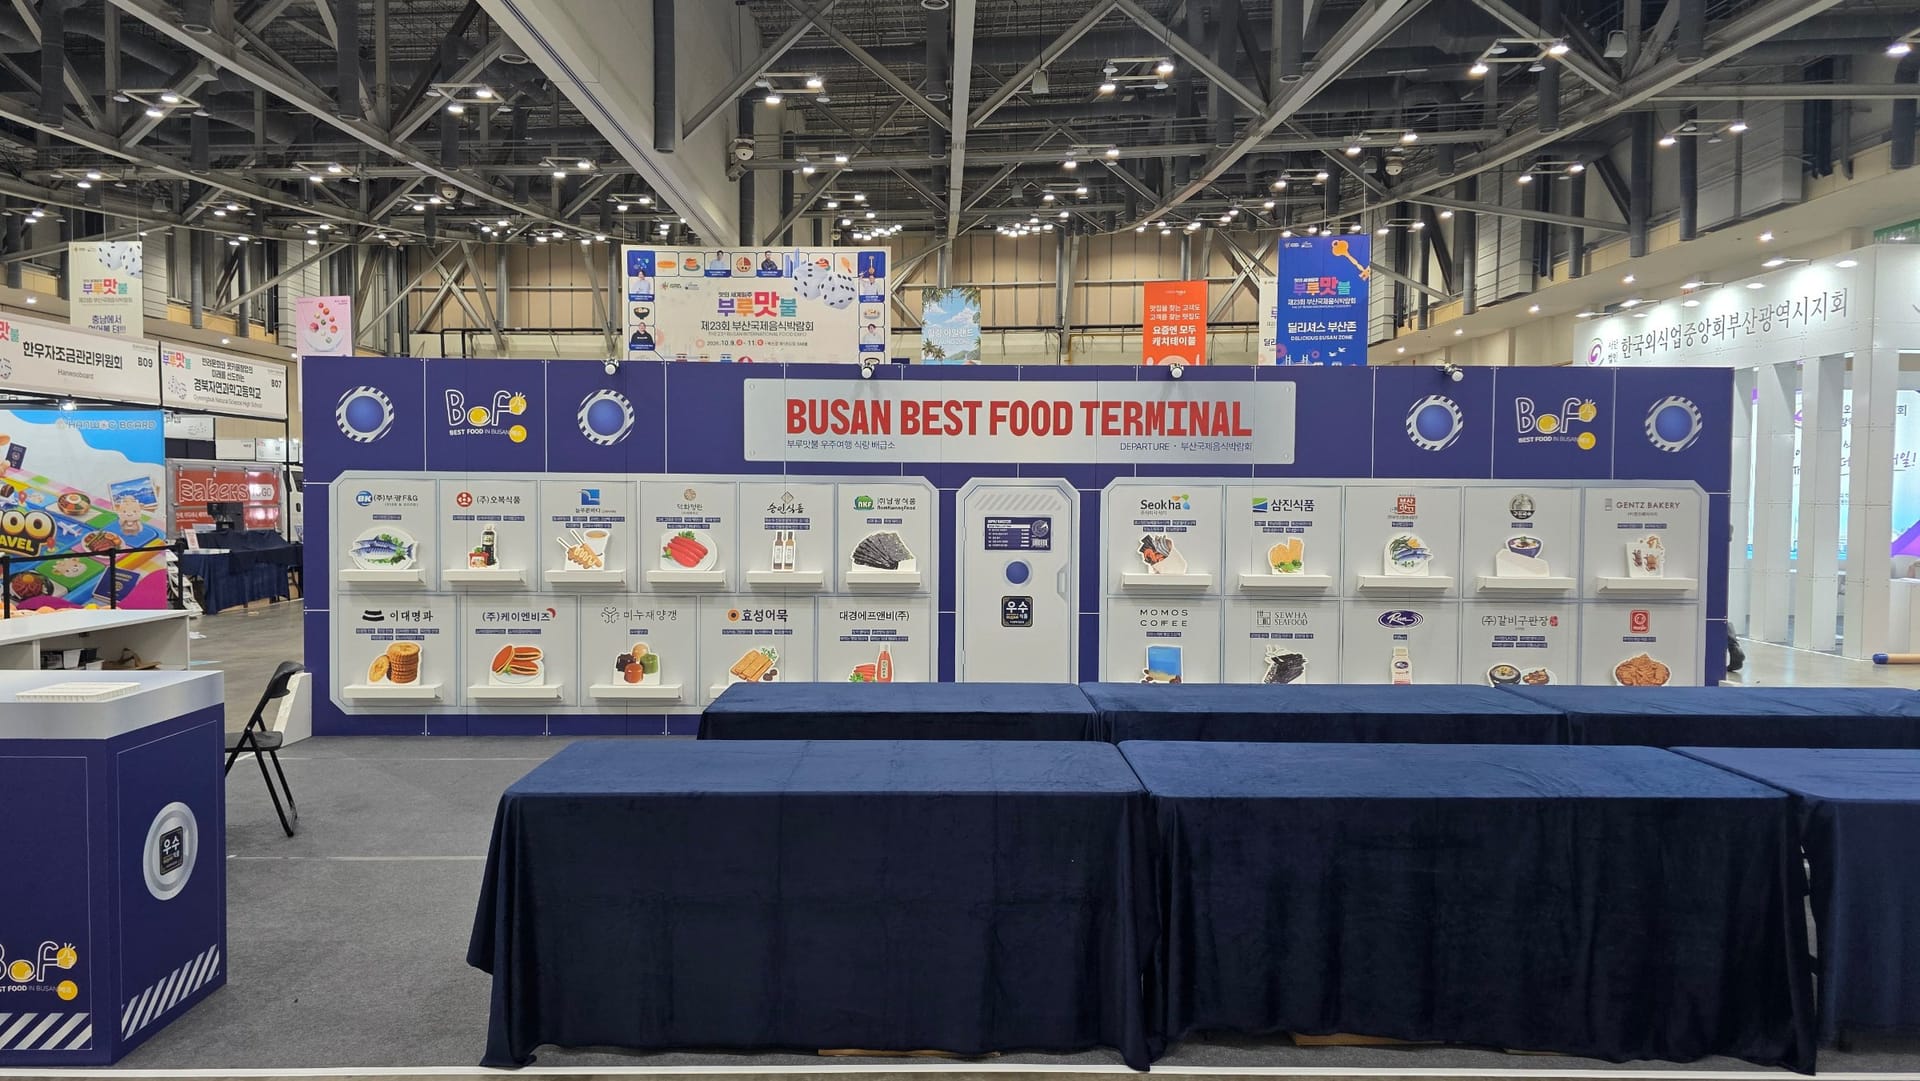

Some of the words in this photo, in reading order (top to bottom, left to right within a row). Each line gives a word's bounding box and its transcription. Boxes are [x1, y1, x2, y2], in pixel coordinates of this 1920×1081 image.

[1293, 277, 1351, 295] 부루맛불
[717, 291, 797, 318] 부루맛불
[1288, 298, 1306, 306] 제23회
[1307, 297, 1356, 305] 부산국제음식박람회
[1169, 304, 1181, 312] 찾는
[92, 315, 122, 324] 충남에서
[1621, 287, 1848, 360] 한국외식업중앙회부산광역시지회
[701, 321, 730, 332] 제23회
[732, 321, 814, 332] 부산국제음식박람회
[1152, 325, 1177, 335] 요즘엔
[1179, 324, 1197, 335] 모두
[1288, 322, 1326, 334] 딜리셔스
[1328, 321, 1357, 332] 부산존
[1152, 336, 1196, 346] 캐치테이블
[23, 341, 123, 371] 한우자조금관리위원회
[137, 357, 153, 368] B09
[193, 377, 262, 400] 경북자연과학고등학교
[270, 379, 282, 389] B07
[786, 399, 892, 436] BUSAN
[900, 400, 983, 436] BEST
[988, 400, 1073, 436] FOOD
[1080, 400, 1252, 437] TERMINAL
[119, 420, 156, 429] BOARD
[787, 440, 819, 450] 부루맛불
[821, 440, 852, 450] 우주여행
[854, 440, 870, 450] 식량
[871, 440, 896, 450] 배급소
[1119, 442, 1169, 451] DEPARTURE
[1180, 442, 1252, 452] 부산국제음식박람회
[178, 477, 250, 503] Bakers
[476, 494, 521, 505] (주)오복식품
[1140, 499, 1181, 510] Seokha
[1616, 501, 1645, 509] GENTZ
[1647, 501, 1681, 509] BAKERY
[1271, 499, 1315, 512] 삼진식품
[1005, 601, 1028, 614] 우수
[1140, 609, 1189, 617] MOMOS
[390, 610, 434, 622] 이대명과
[482, 611, 551, 622] (주)케이엔비즈
[623, 609, 678, 621] 미누재양갱
[741, 609, 788, 622] 효성어묵
[839, 610, 910, 621] 대경에프앤비(주)
[1274, 611, 1308, 619] SEWHA
[1140, 619, 1188, 627] COFFEE
[1274, 618, 1308, 626] SEAFOOD
[1481, 615, 1548, 627] (주)갈비구판장
[162, 835, 180, 856] 우수
